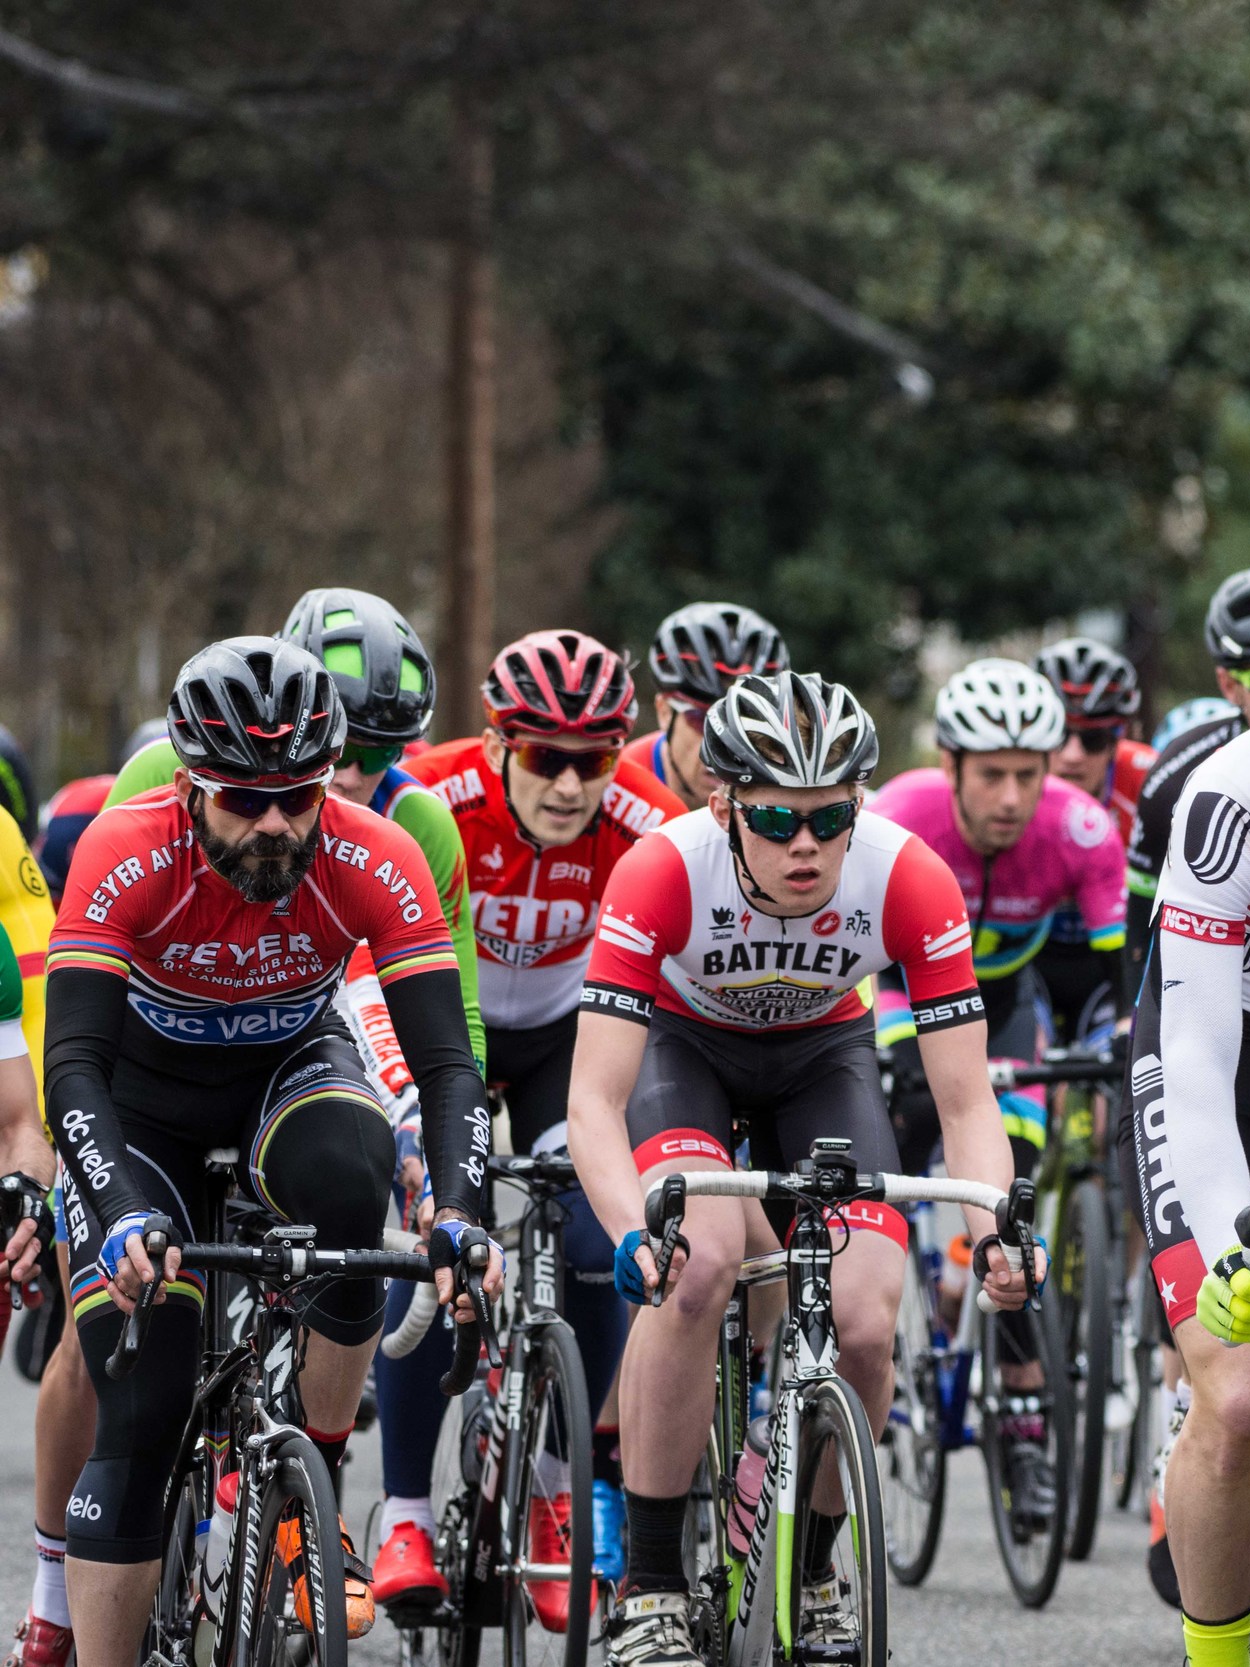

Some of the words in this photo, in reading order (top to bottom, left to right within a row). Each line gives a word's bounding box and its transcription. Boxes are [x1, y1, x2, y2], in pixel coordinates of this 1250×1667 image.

[430, 768, 486, 810] TRA
[603, 782, 666, 836] ETRA
[84, 856, 147, 924] BEYER
[322, 832, 371, 871] YER
[374, 859, 424, 924] AUTO
[159, 931, 317, 967] BEYER
[1164, 911, 1230, 939] NCVC
[249, 953, 322, 976] SUBARU
[703, 941, 862, 978] BATTLEY
[737, 986, 814, 1000] MOTOR
[744, 1006, 804, 1022] YCLES
[148, 1009, 205, 1035] dc
[216, 1003, 306, 1041] velo
[62, 1109, 96, 1143] dc
[464, 1106, 491, 1156] velo
[76, 1139, 116, 1190] velo
[459, 1156, 485, 1188] dc
[1134, 1110, 1155, 1249] UnitedHealthcare
[1143, 1097, 1191, 1235] UHC
[62, 1164, 90, 1251] EYER
[533, 1230, 556, 1309] BMC
[656, 1223, 680, 1273] RAM
[477, 1287, 489, 1322] ULTEGRA
[507, 1371, 525, 1431] BMC
[731, 1355, 743, 1451] SUPER
[780, 1404, 793, 1491] ndale
[241, 1471, 264, 1639] SPECIALIZED
[474, 1545, 492, 1583] BMC
